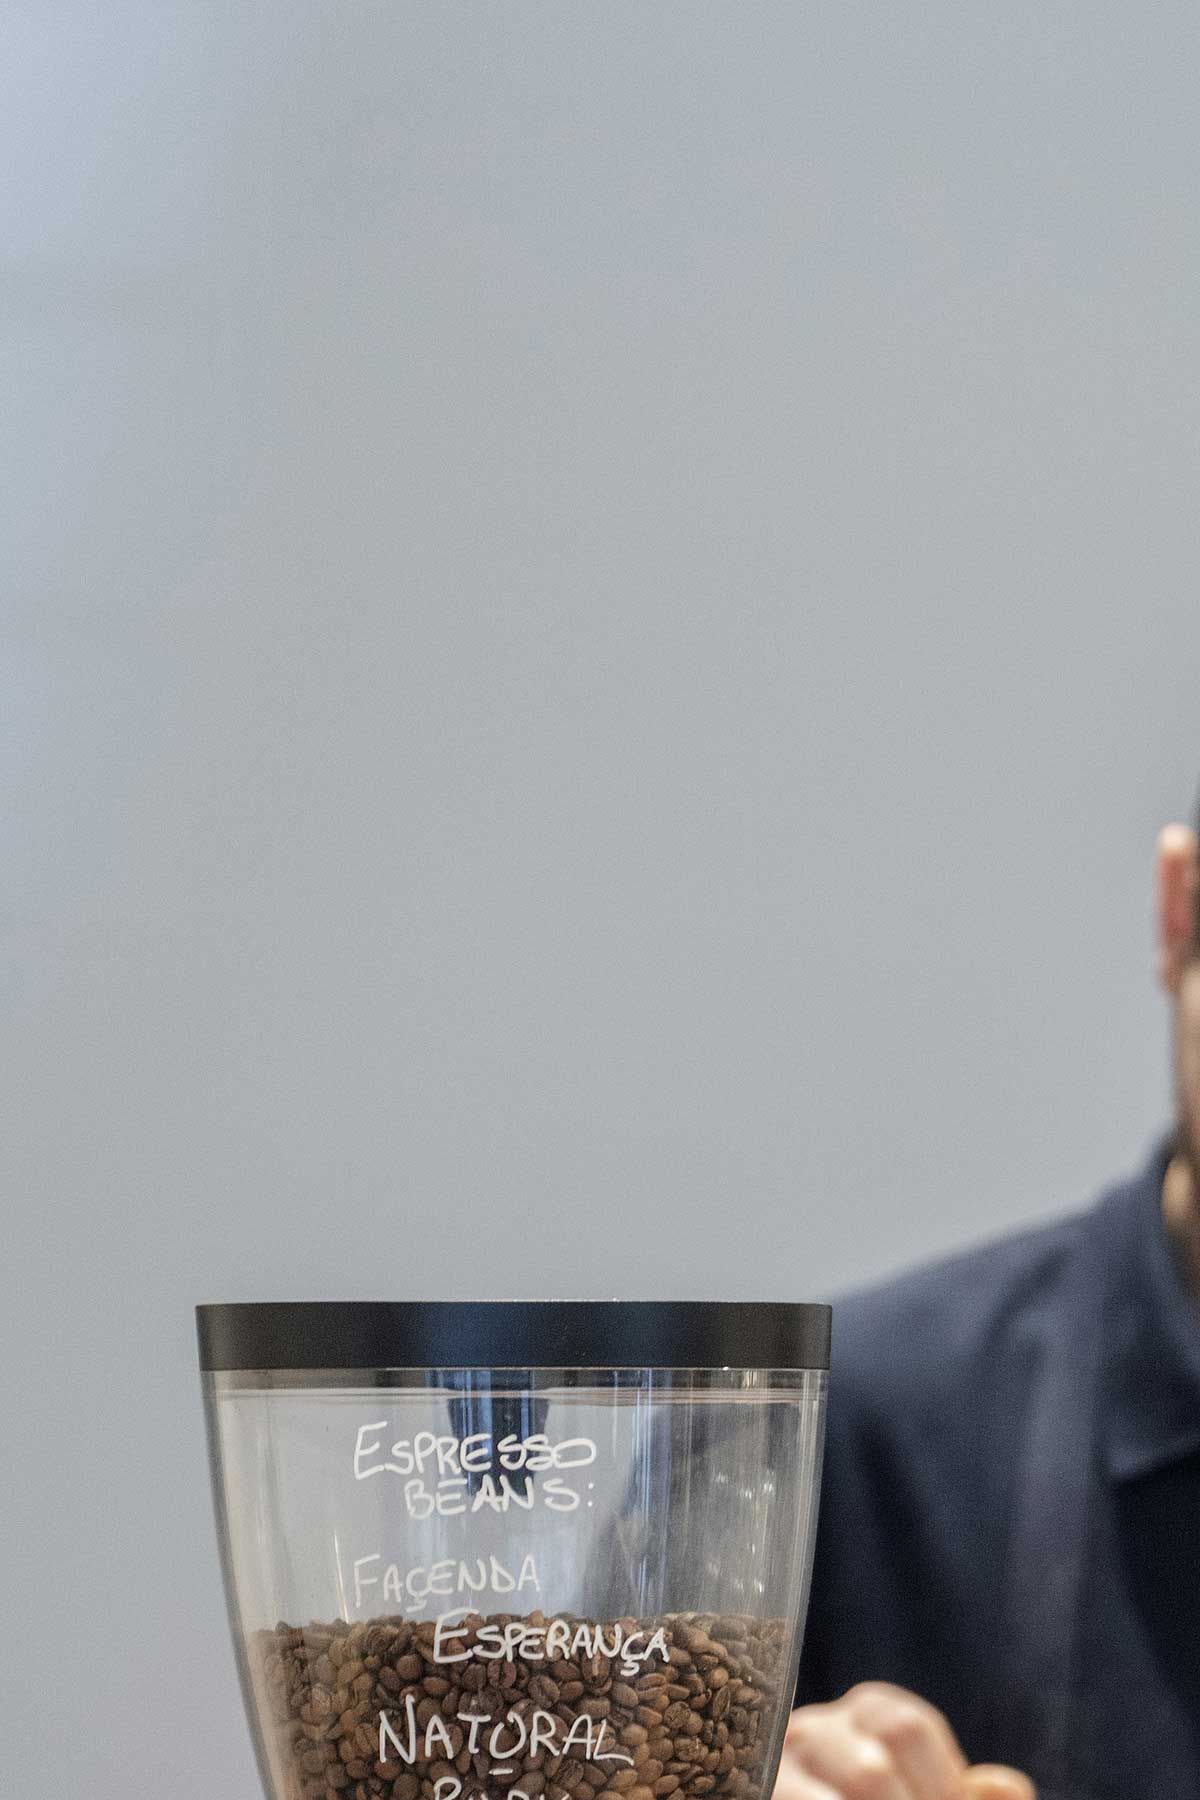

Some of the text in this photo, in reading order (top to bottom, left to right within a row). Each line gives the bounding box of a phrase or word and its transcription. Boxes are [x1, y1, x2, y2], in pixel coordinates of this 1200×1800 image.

[353, 1421, 597, 1480] ESPRESSO
[403, 1475, 595, 1520] BEANS:
[432, 1607, 671, 1677] ESPERANÇA
